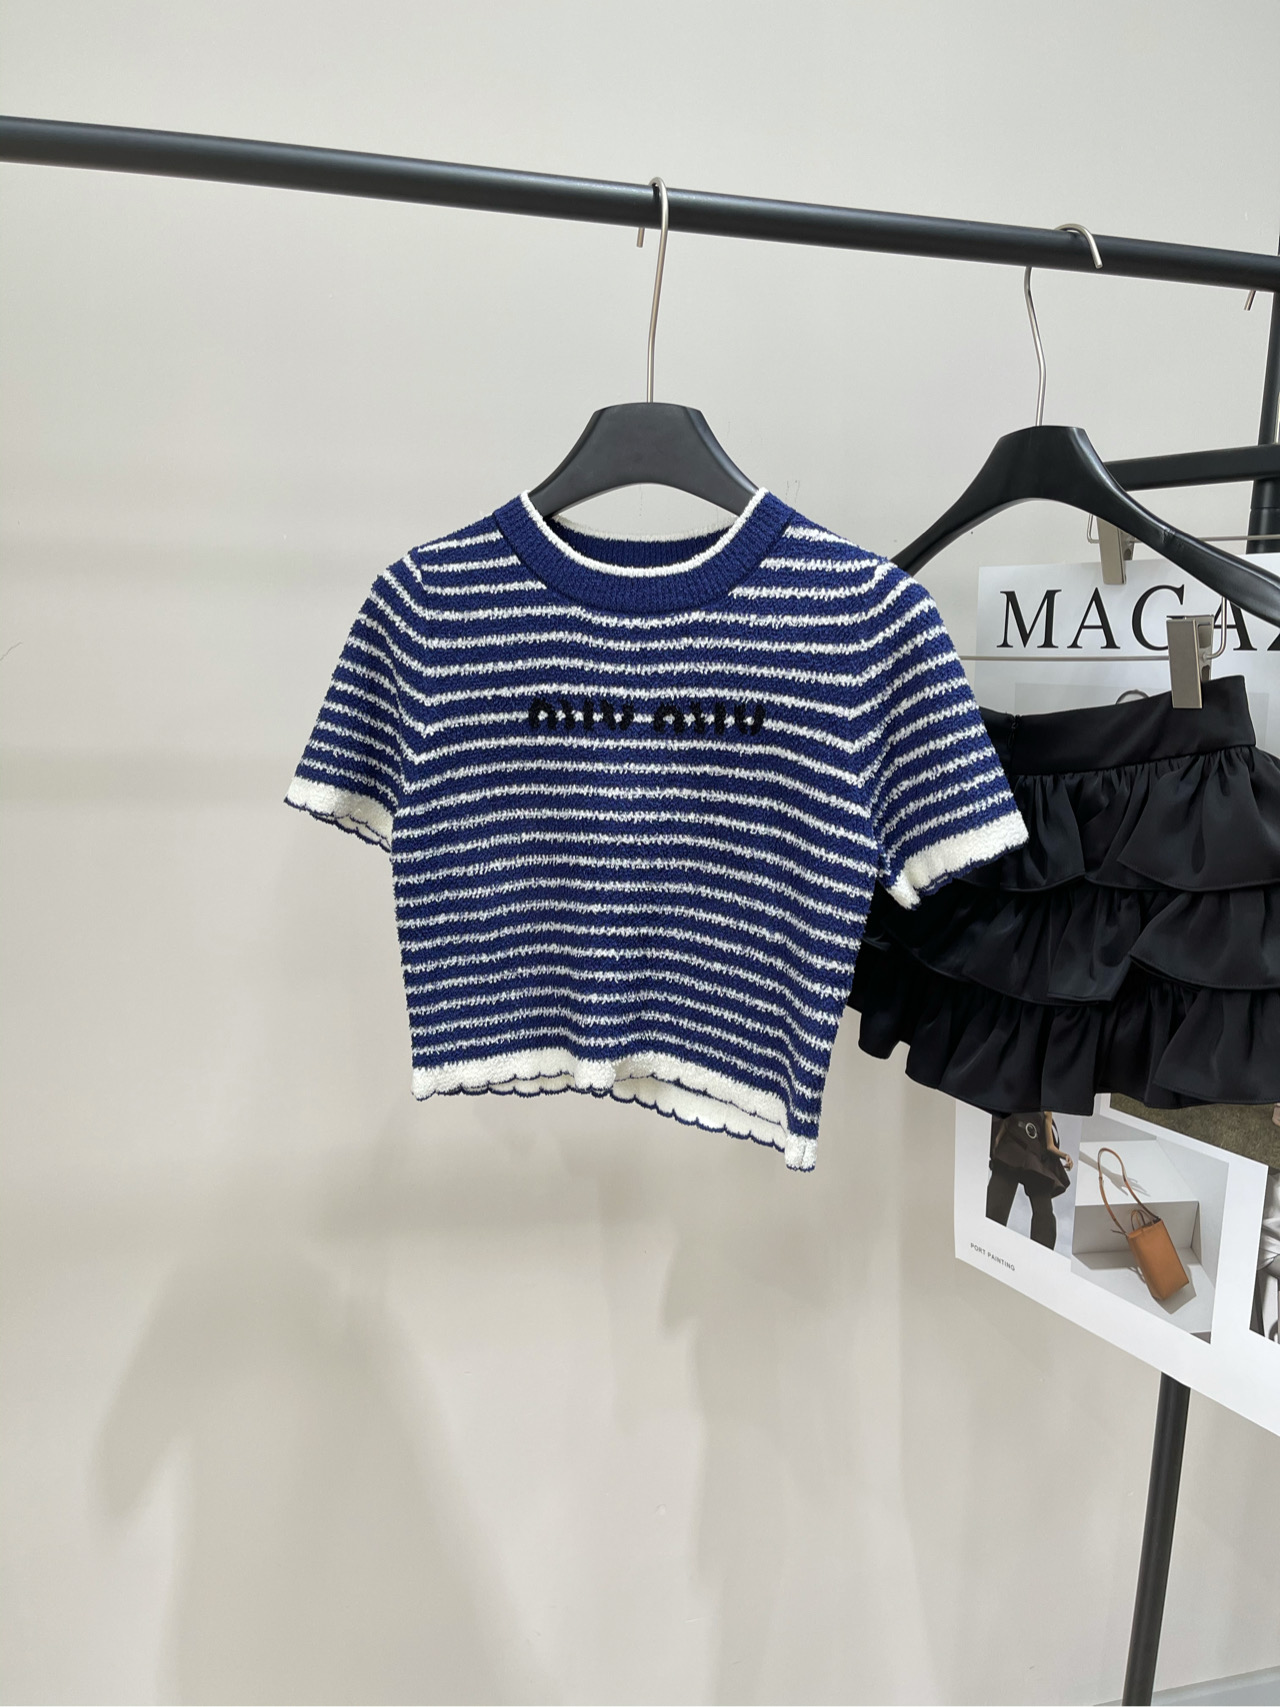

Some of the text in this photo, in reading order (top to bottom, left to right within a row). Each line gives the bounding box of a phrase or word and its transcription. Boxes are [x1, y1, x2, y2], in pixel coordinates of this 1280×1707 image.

[996, 584, 1280, 651] MAGA
[970, 1242, 1016, 1272] PORT PAINTING
